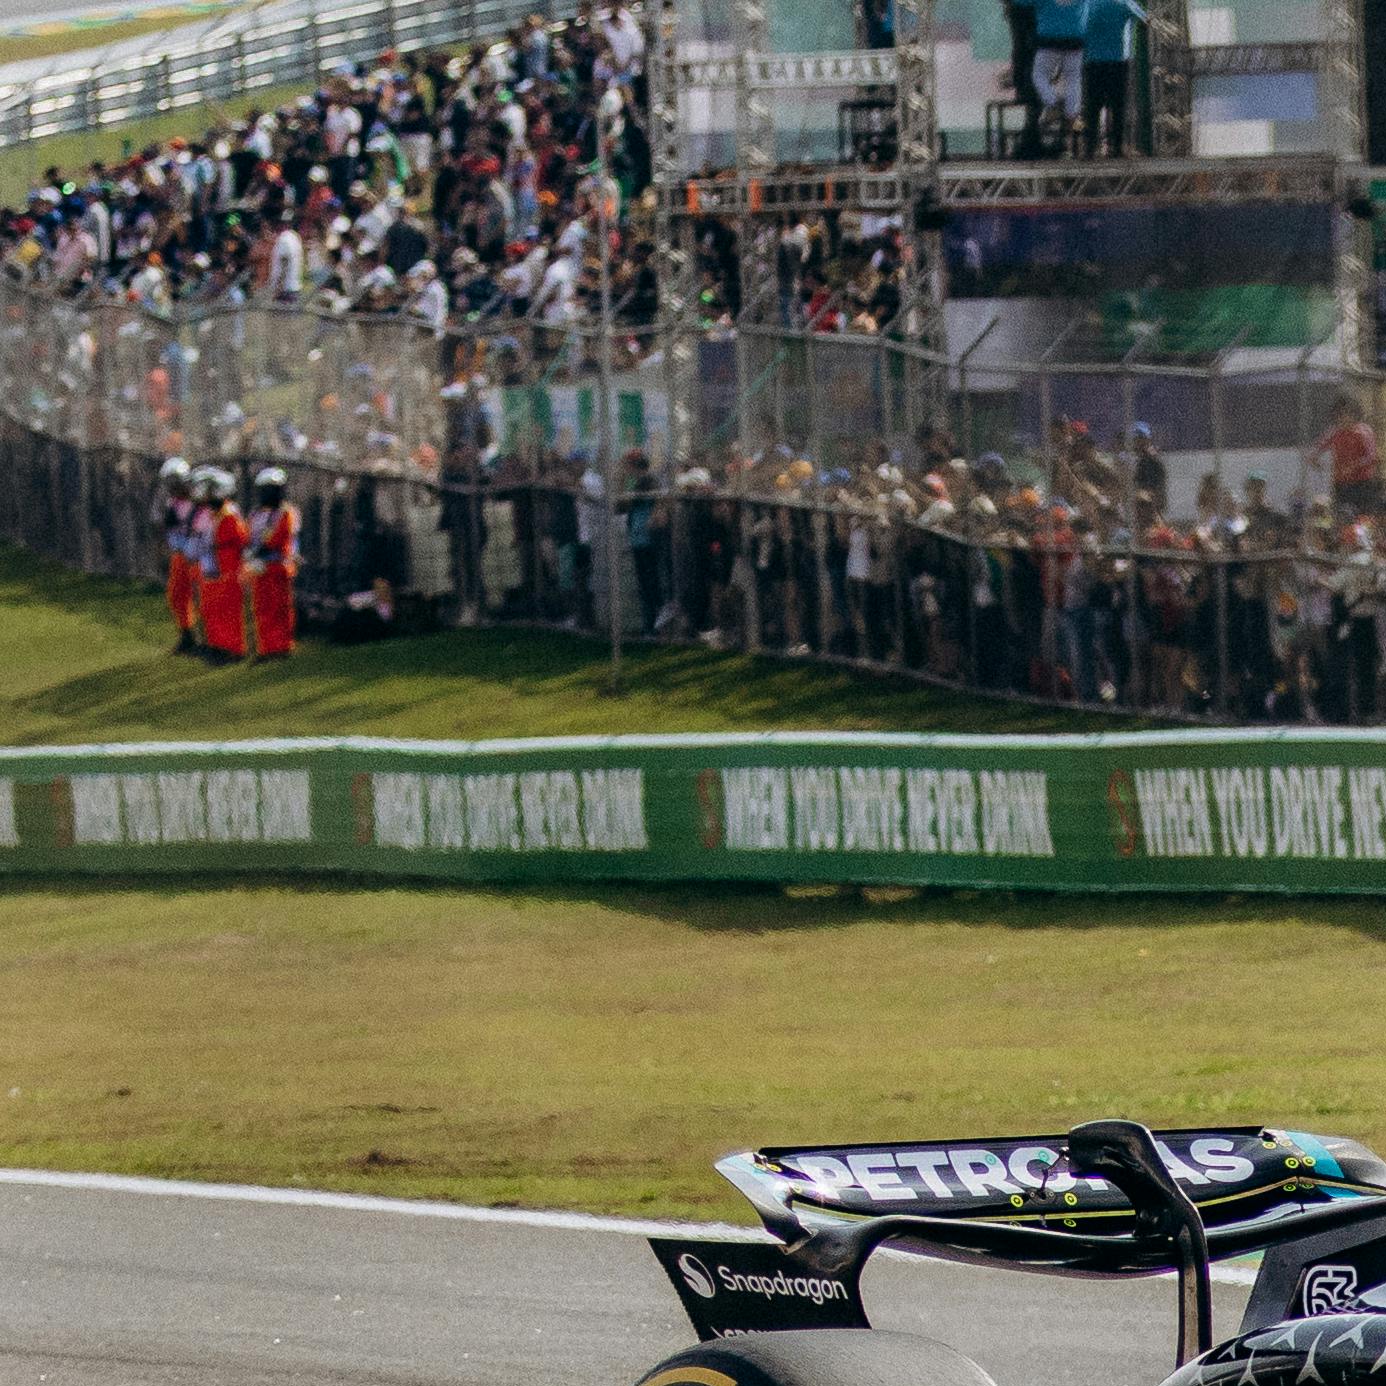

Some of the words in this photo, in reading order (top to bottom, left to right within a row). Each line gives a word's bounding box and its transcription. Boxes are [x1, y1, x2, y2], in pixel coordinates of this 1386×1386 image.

[1135, 768, 1213, 856] WHEN
[1211, 768, 1267, 857] YOU
[1270, 766, 1348, 858] DRIVE
[797, 1138, 1254, 1201] PETROAS
[717, 1265, 848, 1305] Snapdragon
